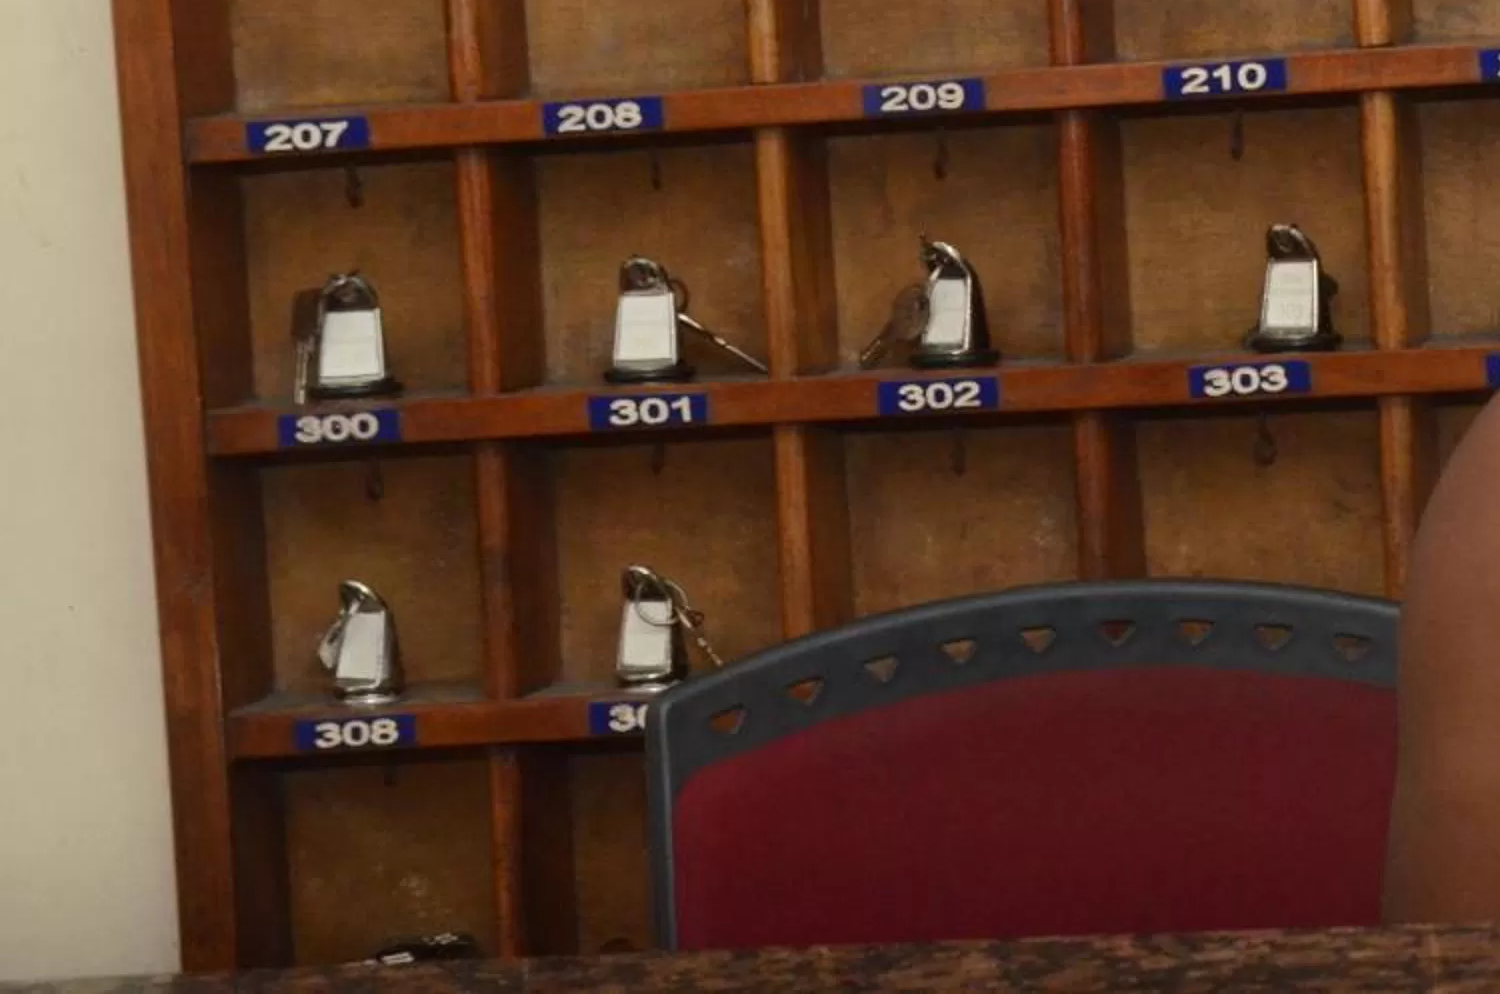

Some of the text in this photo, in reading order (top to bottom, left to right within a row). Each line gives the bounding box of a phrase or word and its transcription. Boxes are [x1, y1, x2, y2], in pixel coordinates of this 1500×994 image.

[1181, 62, 1267, 94] 210
[880, 82, 965, 112] 209
[557, 101, 642, 133] 208
[264, 120, 348, 151] 207
[898, 381, 981, 411] 302
[1204, 364, 1288, 397] 303
[609, 396, 692, 426] 301
[295, 412, 379, 443] 300
[315, 718, 399, 748] 308
